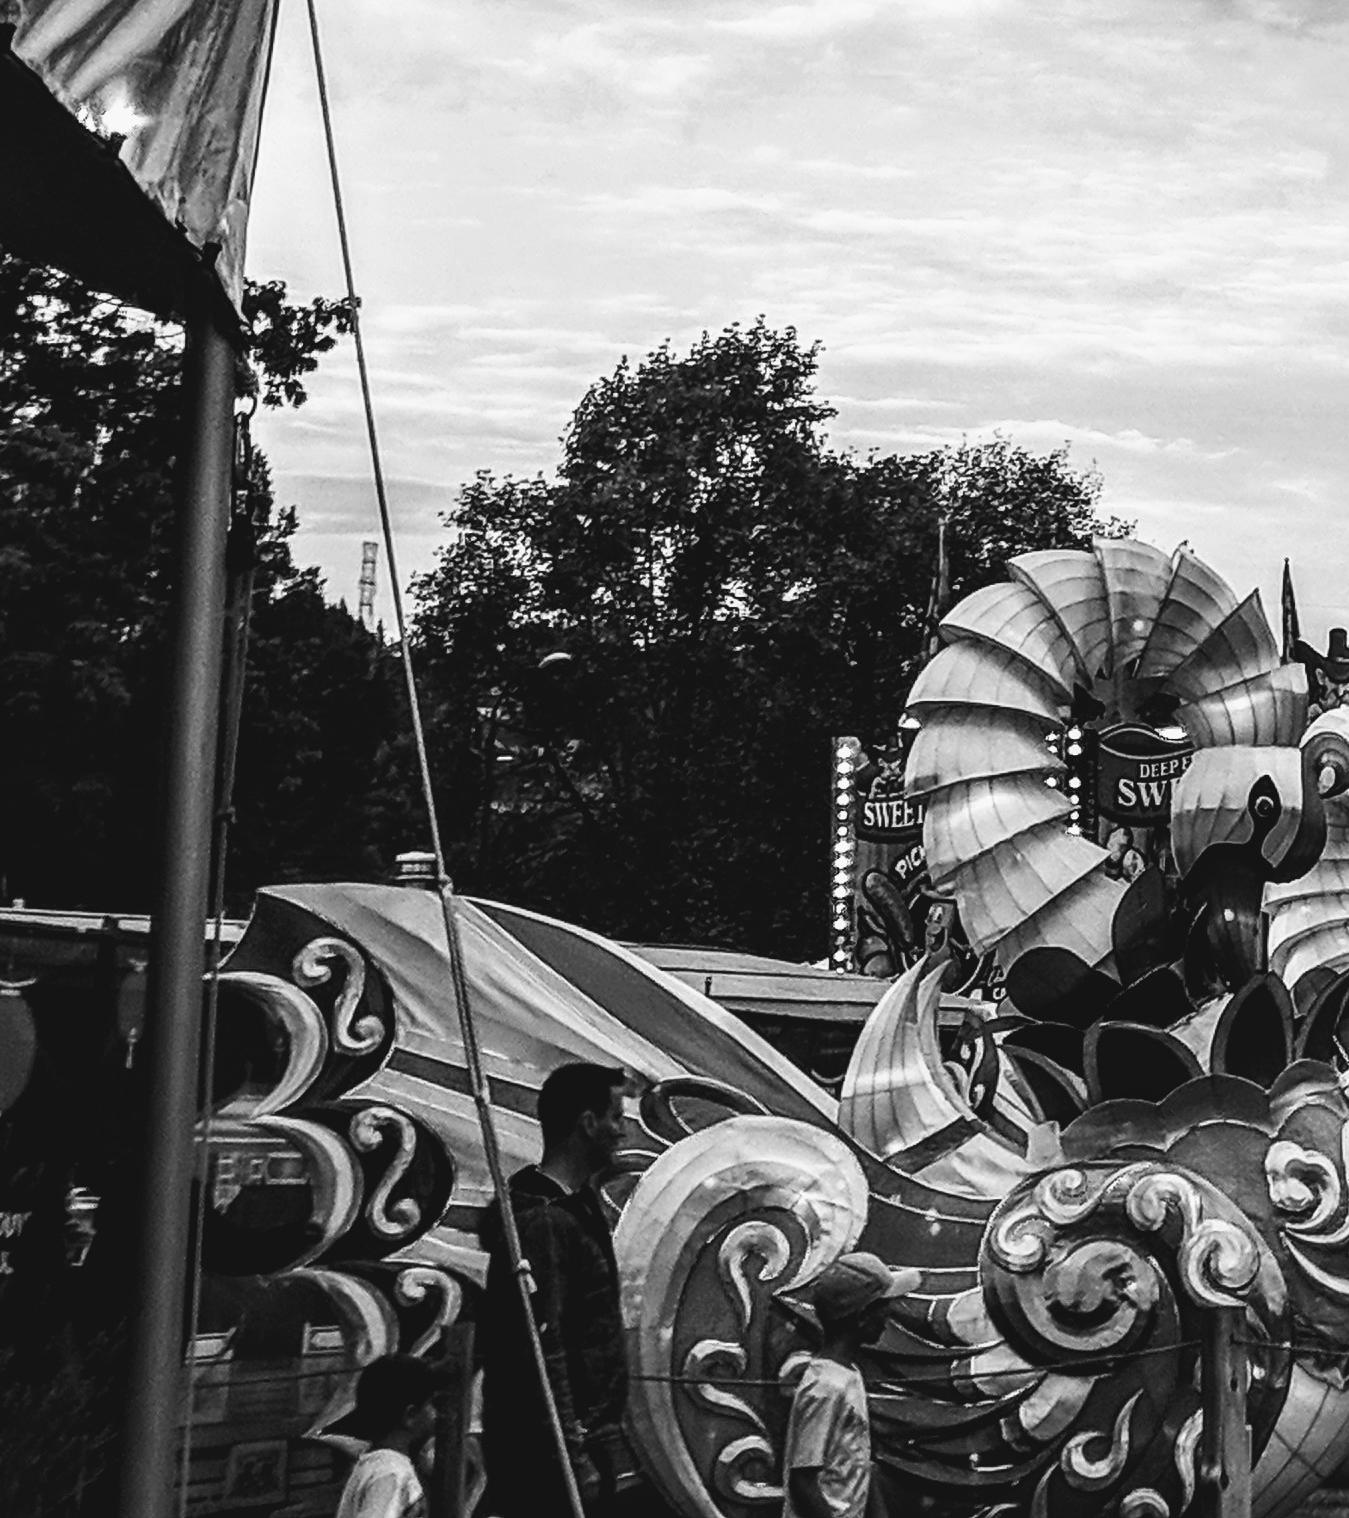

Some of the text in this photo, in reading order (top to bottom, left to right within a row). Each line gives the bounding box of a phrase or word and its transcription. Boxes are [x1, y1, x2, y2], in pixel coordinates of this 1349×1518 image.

[1139, 759, 1179, 778] DEEP
[1118, 777, 1174, 807] SW
[894, 845, 926, 880] PIC
